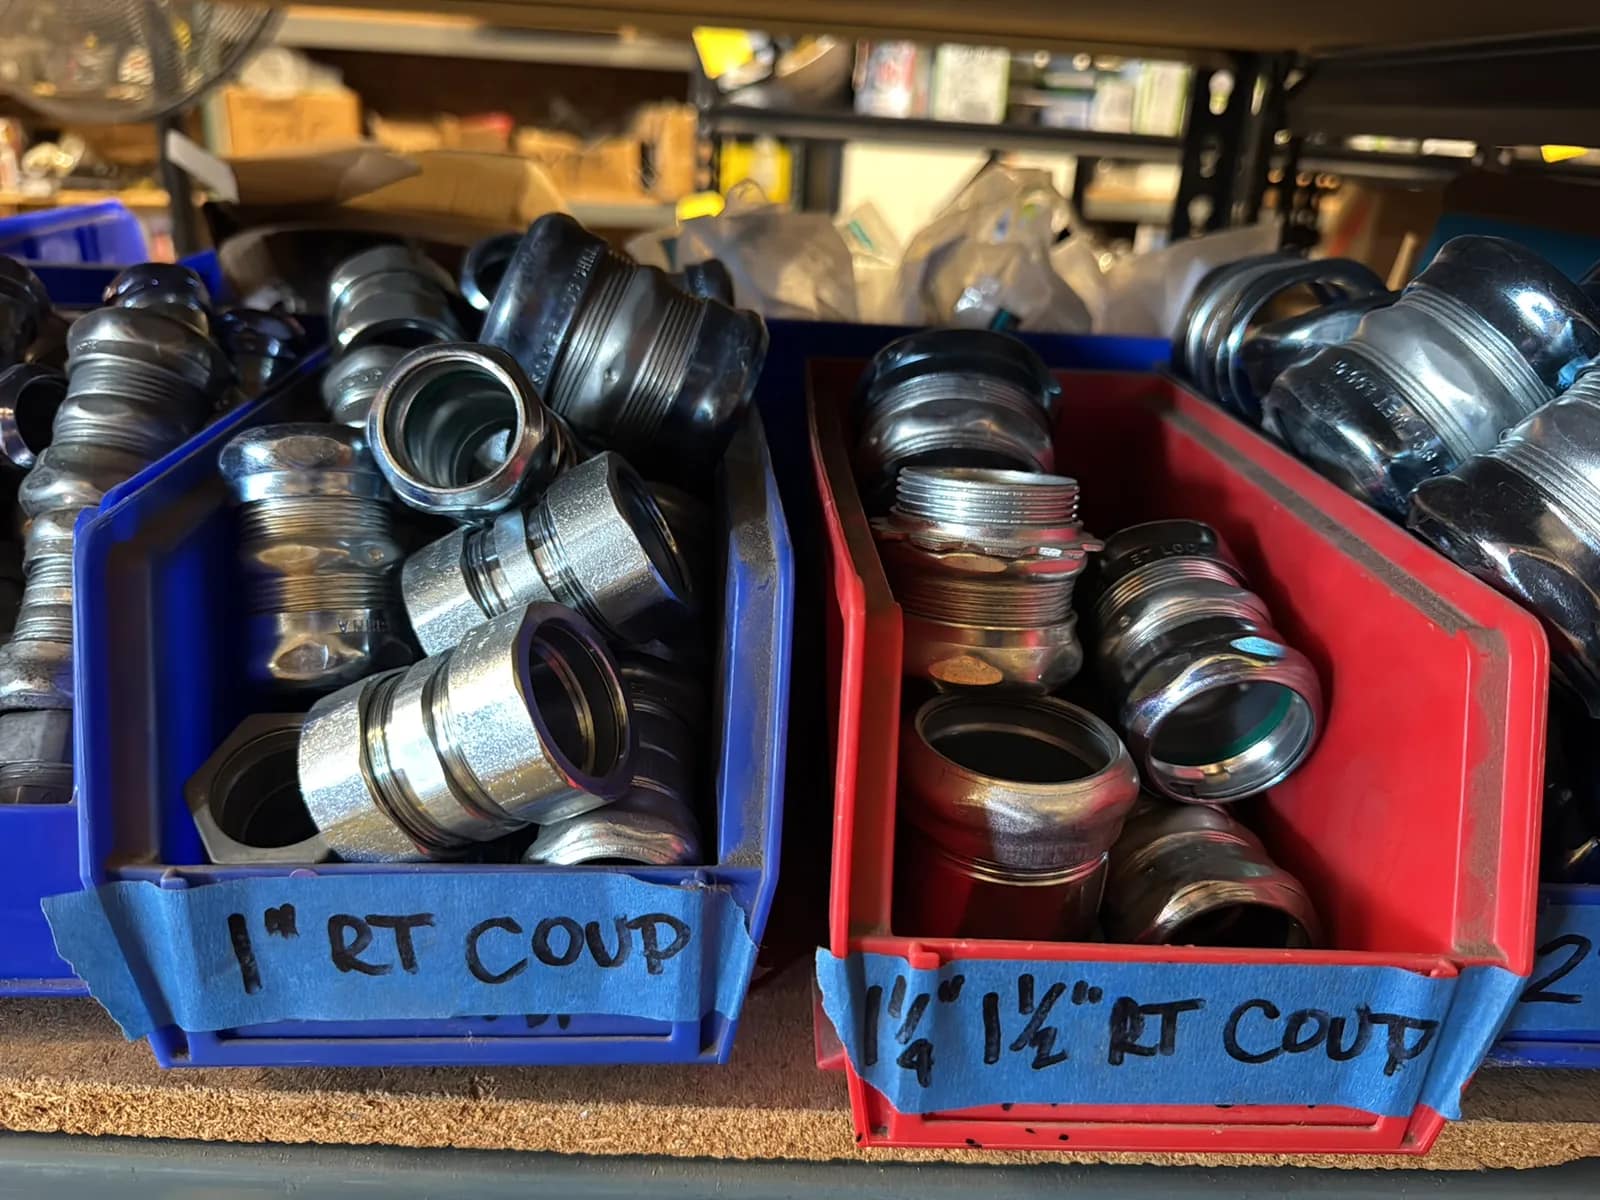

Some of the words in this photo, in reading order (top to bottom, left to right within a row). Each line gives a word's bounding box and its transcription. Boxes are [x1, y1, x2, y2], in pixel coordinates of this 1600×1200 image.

[228, 903, 299, 994] 1"
[328, 913, 436, 976] RT
[465, 912, 692, 985] COUP
[1519, 933, 1600, 1004] 2
[1108, 996, 1207, 1067] RT
[1223, 998, 1440, 1078] COUP
